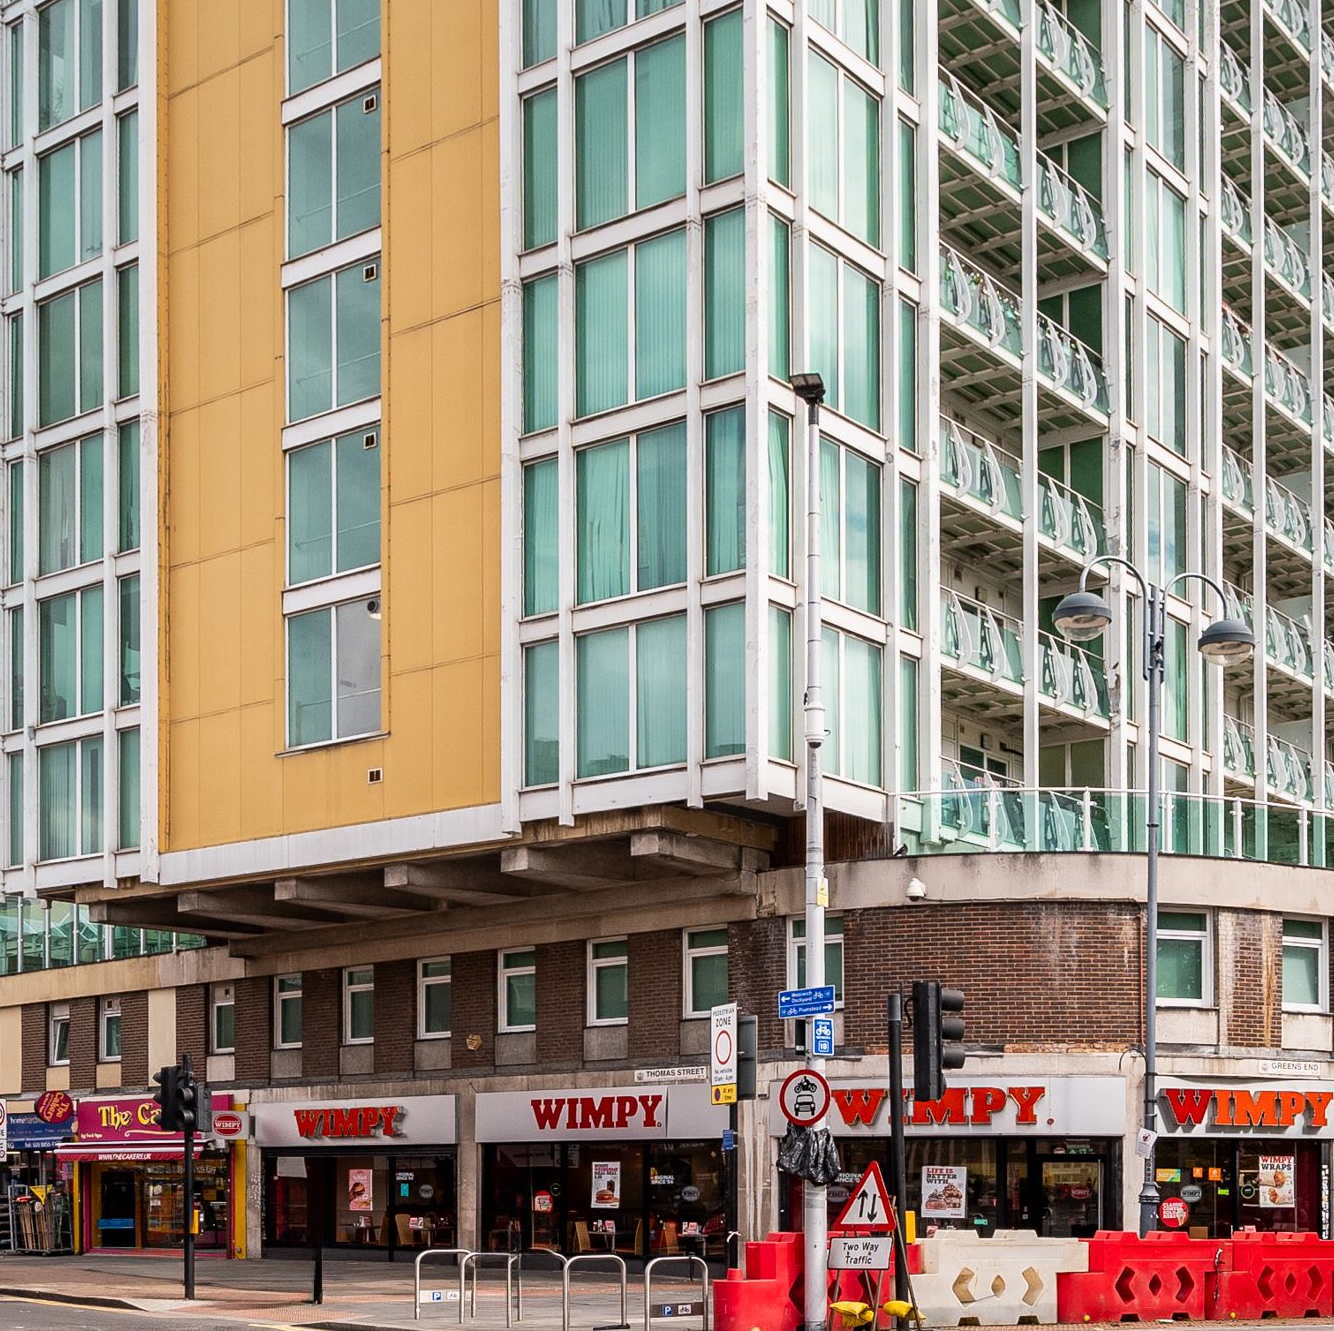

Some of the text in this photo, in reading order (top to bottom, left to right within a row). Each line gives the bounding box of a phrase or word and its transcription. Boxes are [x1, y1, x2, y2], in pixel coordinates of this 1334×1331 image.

[712, 1008, 735, 1016] PEDESTRIAN
[715, 1016, 732, 1027] ZONE
[1271, 1062, 1318, 1071] GREENS END
[531, 1095, 663, 1130] WIMPY
[1165, 1088, 1334, 1127] WIMPY
[98, 1105, 132, 1130] The
[294, 1106, 400, 1138] WIMPY
[215, 1121, 241, 1129] WIMPY
[843, 1242, 879, 1252] Two Way
[845, 1255, 872, 1264] Traffic
